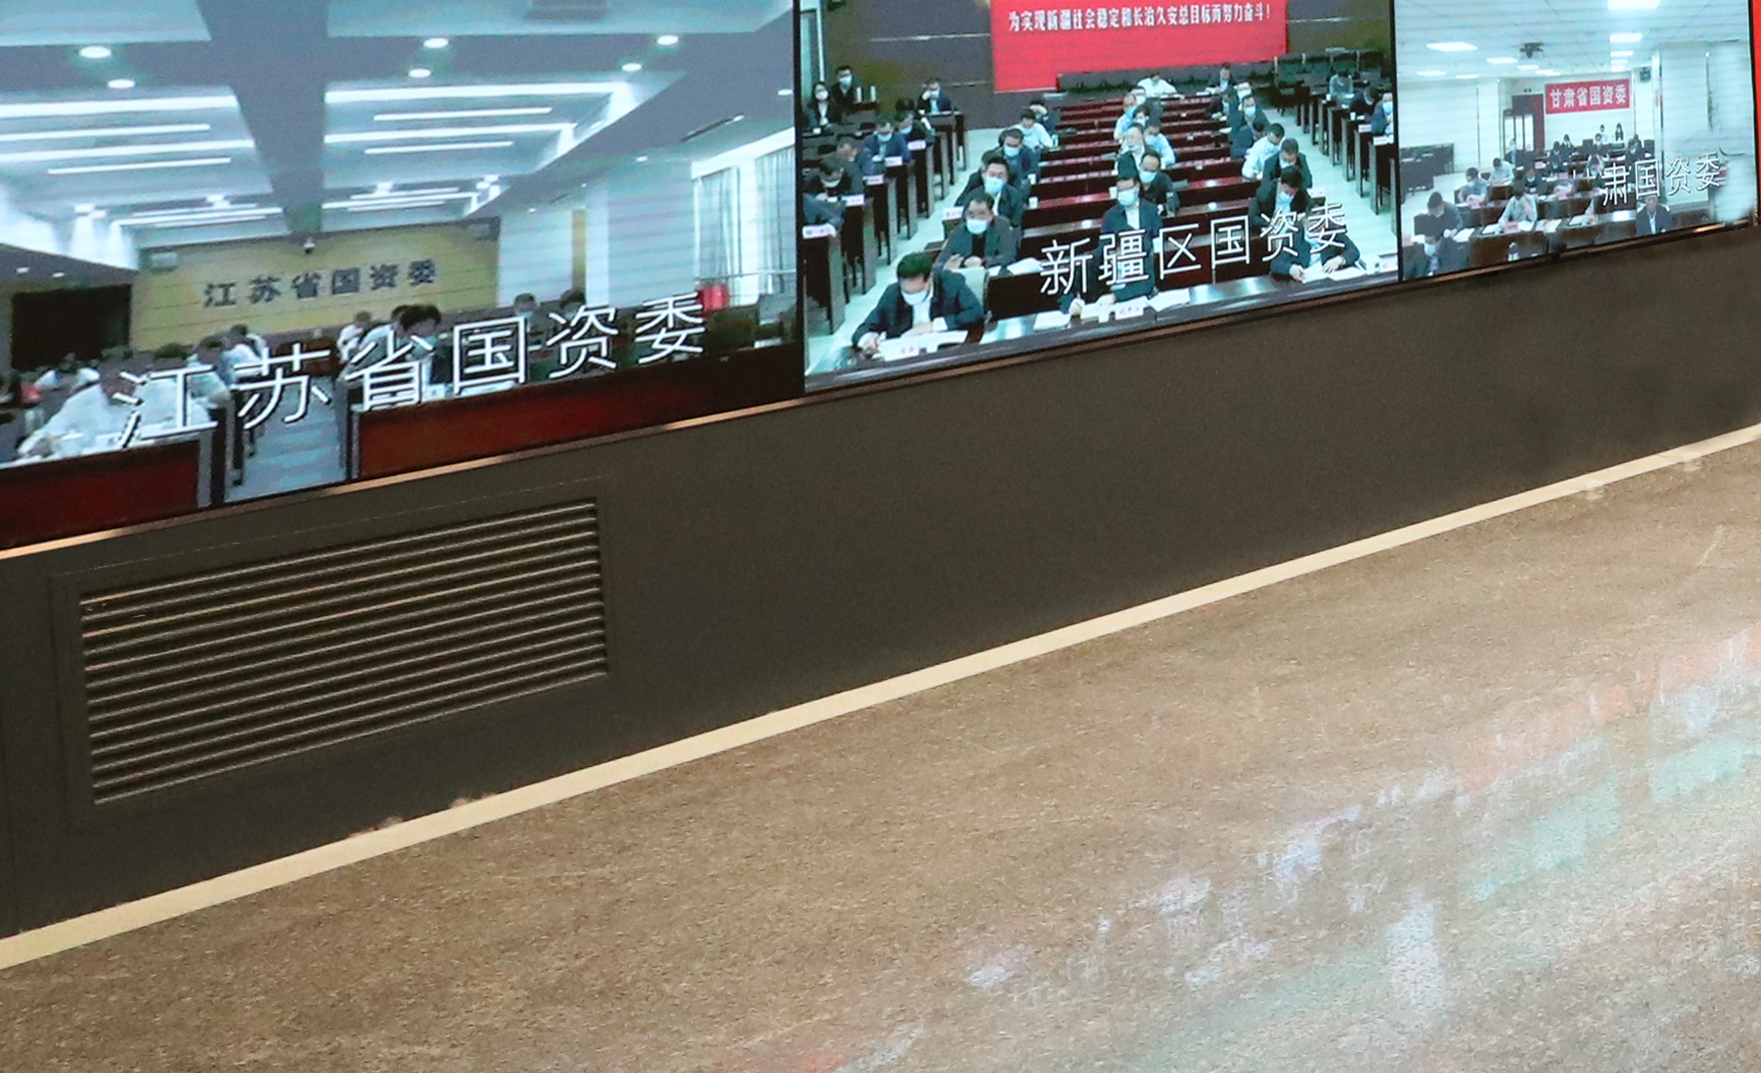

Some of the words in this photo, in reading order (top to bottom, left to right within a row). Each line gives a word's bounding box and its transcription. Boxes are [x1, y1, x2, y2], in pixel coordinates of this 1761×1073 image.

[1549, 84, 1627, 109] 甘肃省国资委
[203, 258, 437, 308] 江苏省国资委
[1040, 203, 1347, 296] 新疆区国资委
[121, 290, 706, 448] 江苏省国资委
